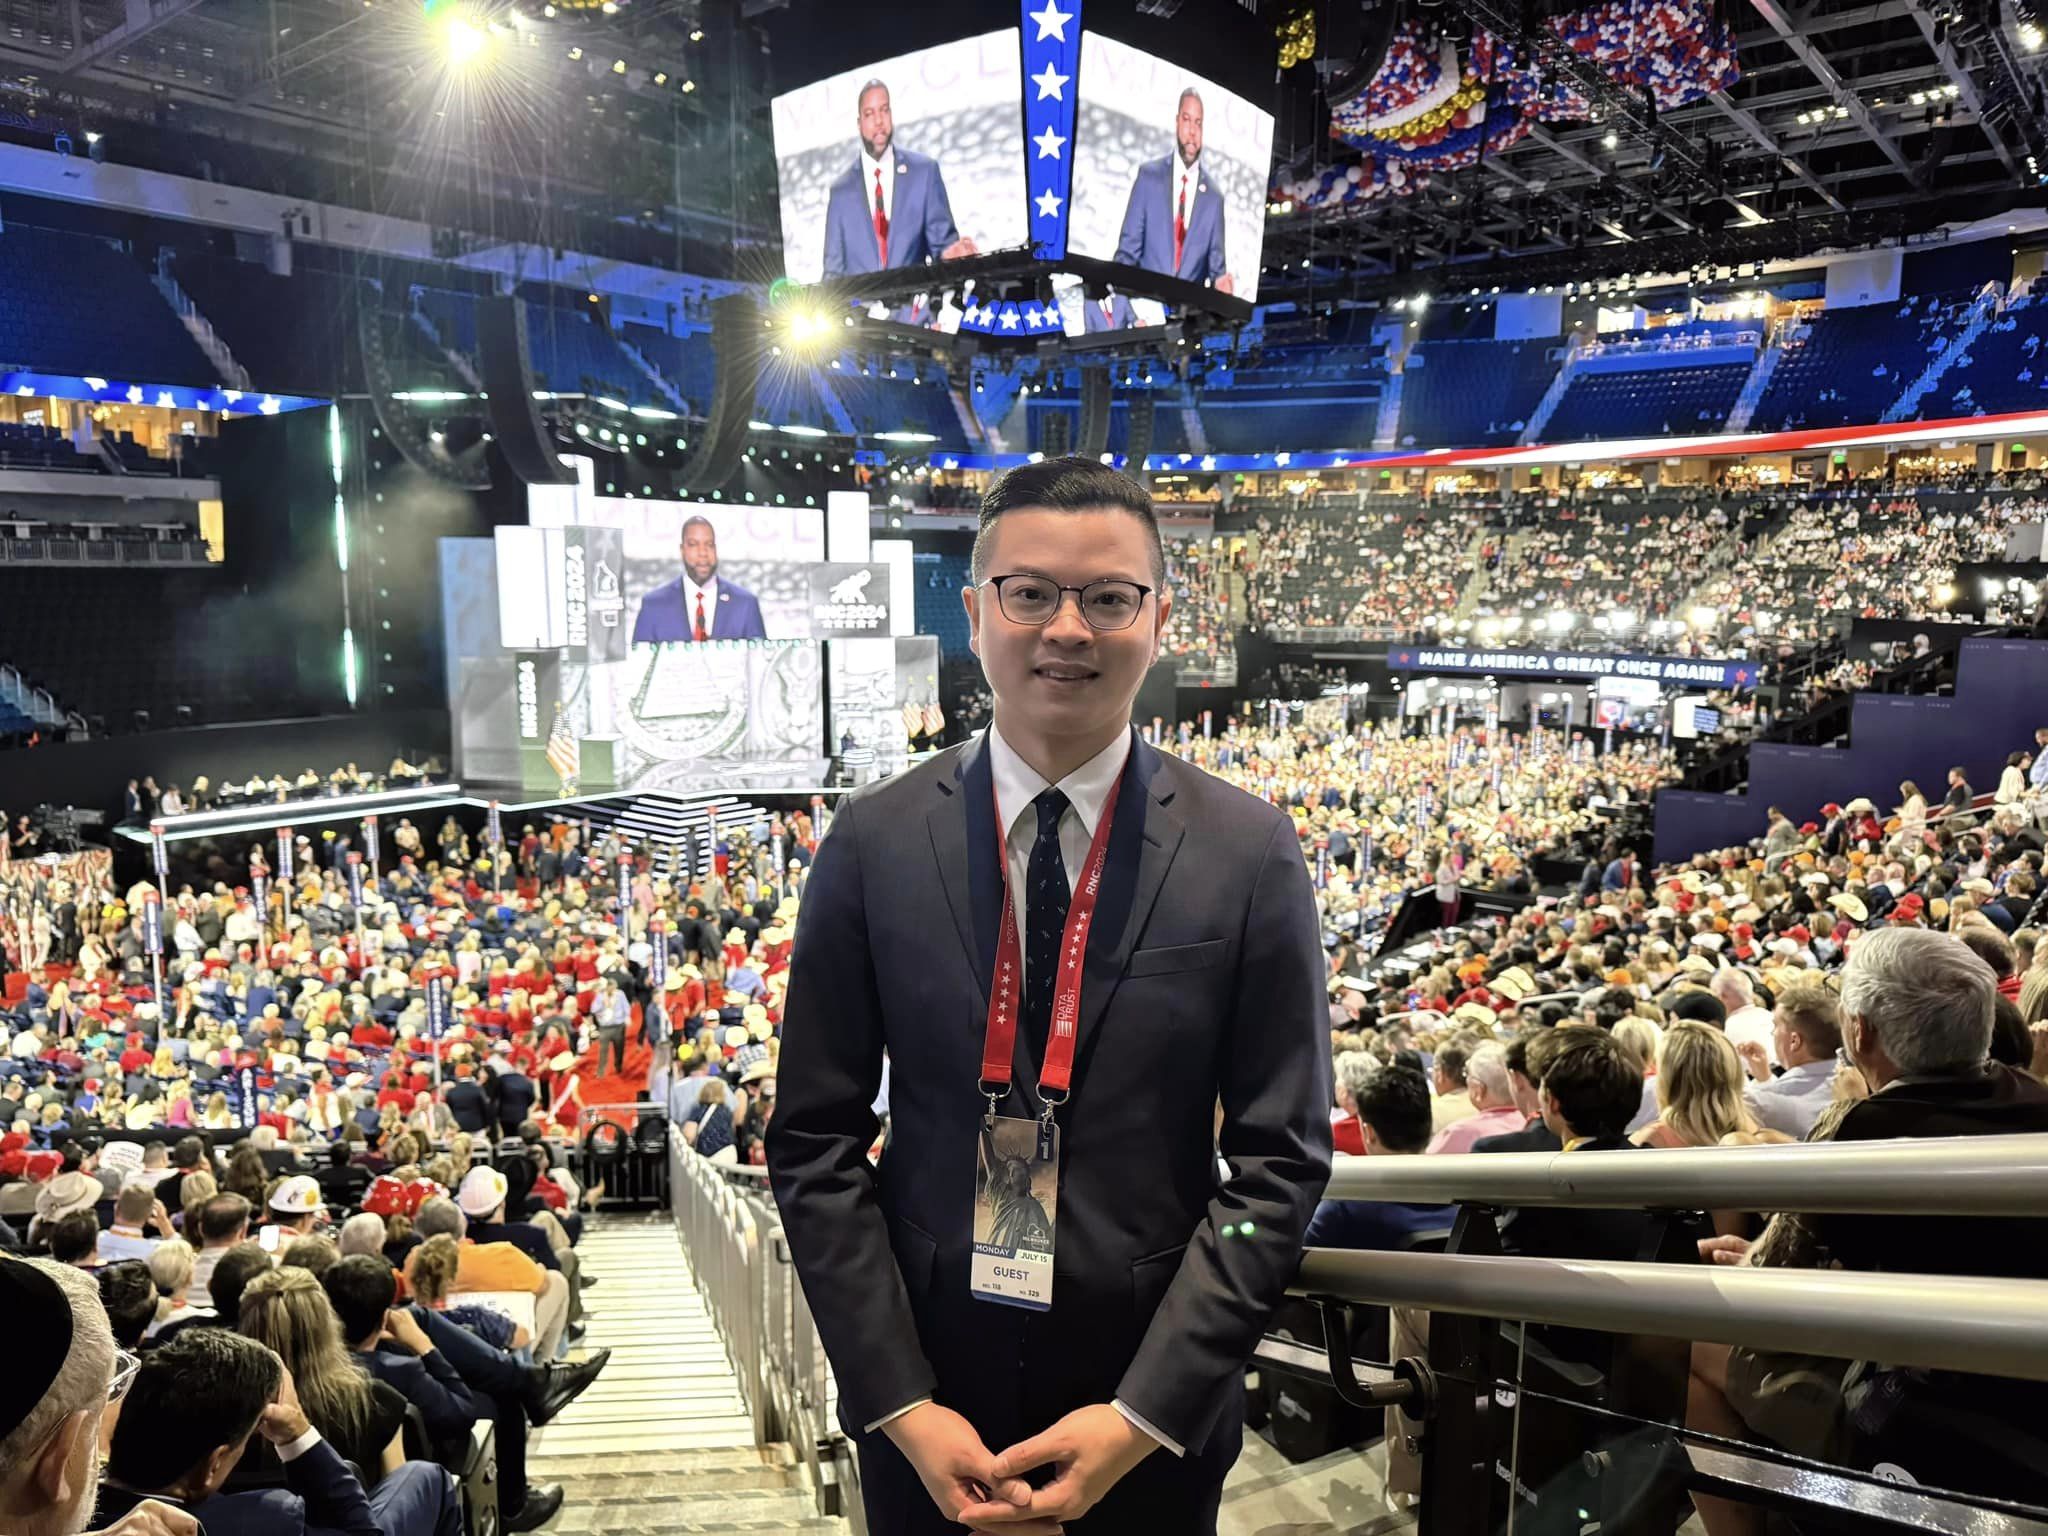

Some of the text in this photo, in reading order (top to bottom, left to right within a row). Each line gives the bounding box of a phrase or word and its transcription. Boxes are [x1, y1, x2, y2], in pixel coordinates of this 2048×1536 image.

[566, 545, 586, 646] RNC2024
[1418, 652, 1725, 682] MAKE AMERICA GREAT ONCE AGAIN!
[1056, 994, 1069, 1020] DATA
[1064, 988, 1077, 1019] TRUST
[975, 1244, 1010, 1257] MONDAY
[1021, 1252, 1048, 1263] JULY 15
[993, 1266, 1030, 1281] GUEST
